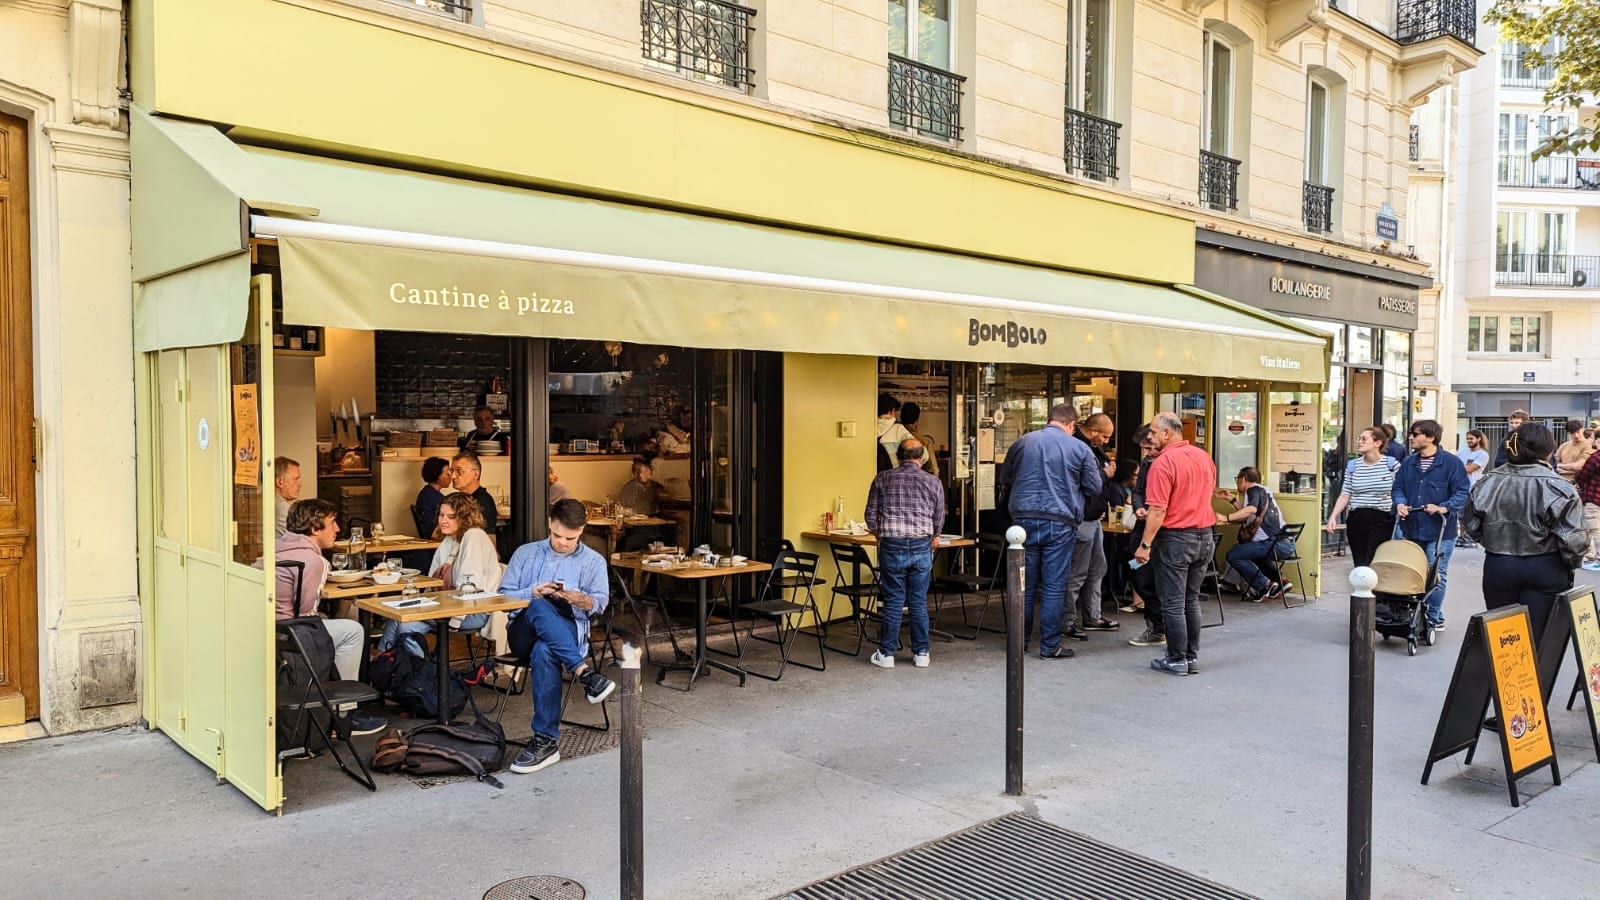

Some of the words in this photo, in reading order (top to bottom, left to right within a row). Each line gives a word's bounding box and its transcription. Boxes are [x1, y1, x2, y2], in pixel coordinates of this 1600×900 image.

[389, 282, 490, 309] Cantine
[498, 290, 511, 310] à
[517, 292, 575, 315] pizza
[1270, 277, 1331, 300] BOULANGERIE
[1380, 296, 1416, 314] PATISSERIE
[1260, 355, 1275, 367] Vins
[1276, 356, 1301, 369] italiens
